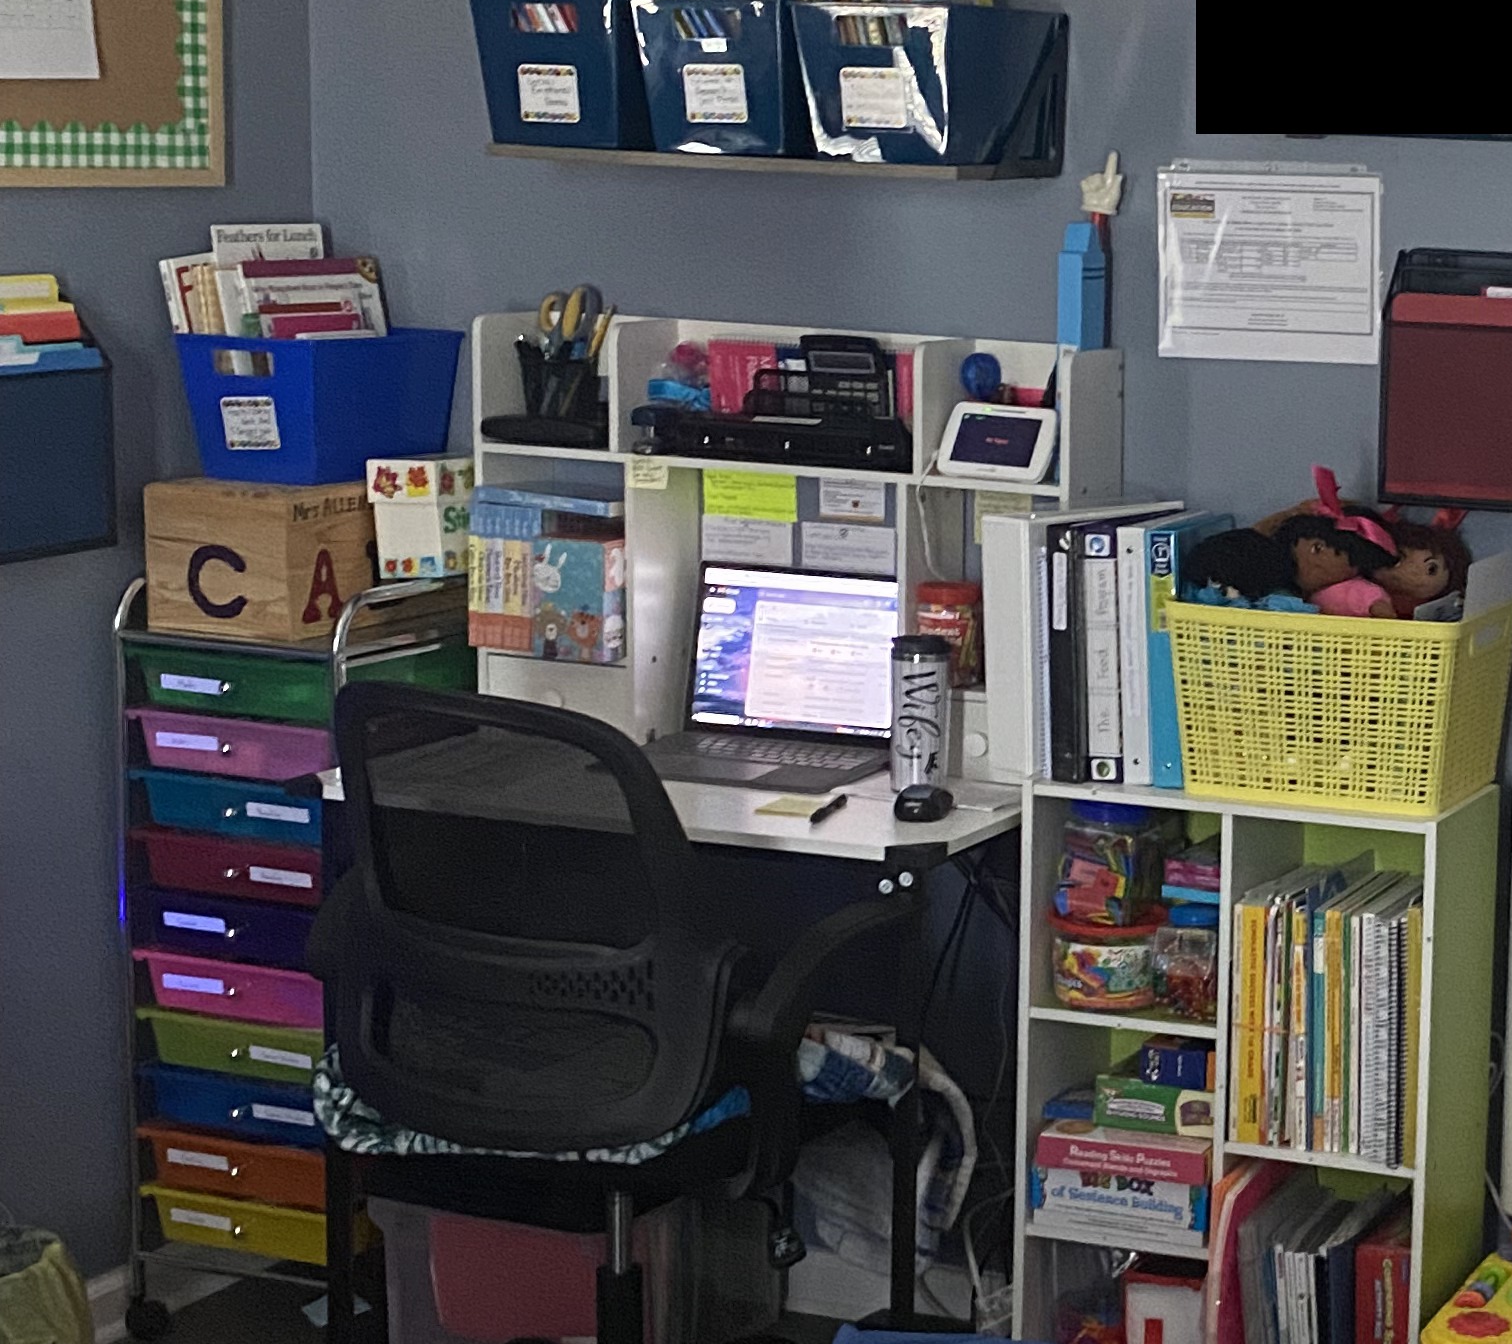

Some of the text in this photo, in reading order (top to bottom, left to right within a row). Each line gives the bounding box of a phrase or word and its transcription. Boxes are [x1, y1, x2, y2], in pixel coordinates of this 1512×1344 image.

[188, 544, 248, 618] C
[302, 547, 344, 623] A
[1135, 1152, 1171, 1168] Puzzles
[1051, 1184, 1066, 1198] of
[1068, 1188, 1129, 1207] Sentence
[1132, 1196, 1184, 1221] Building
